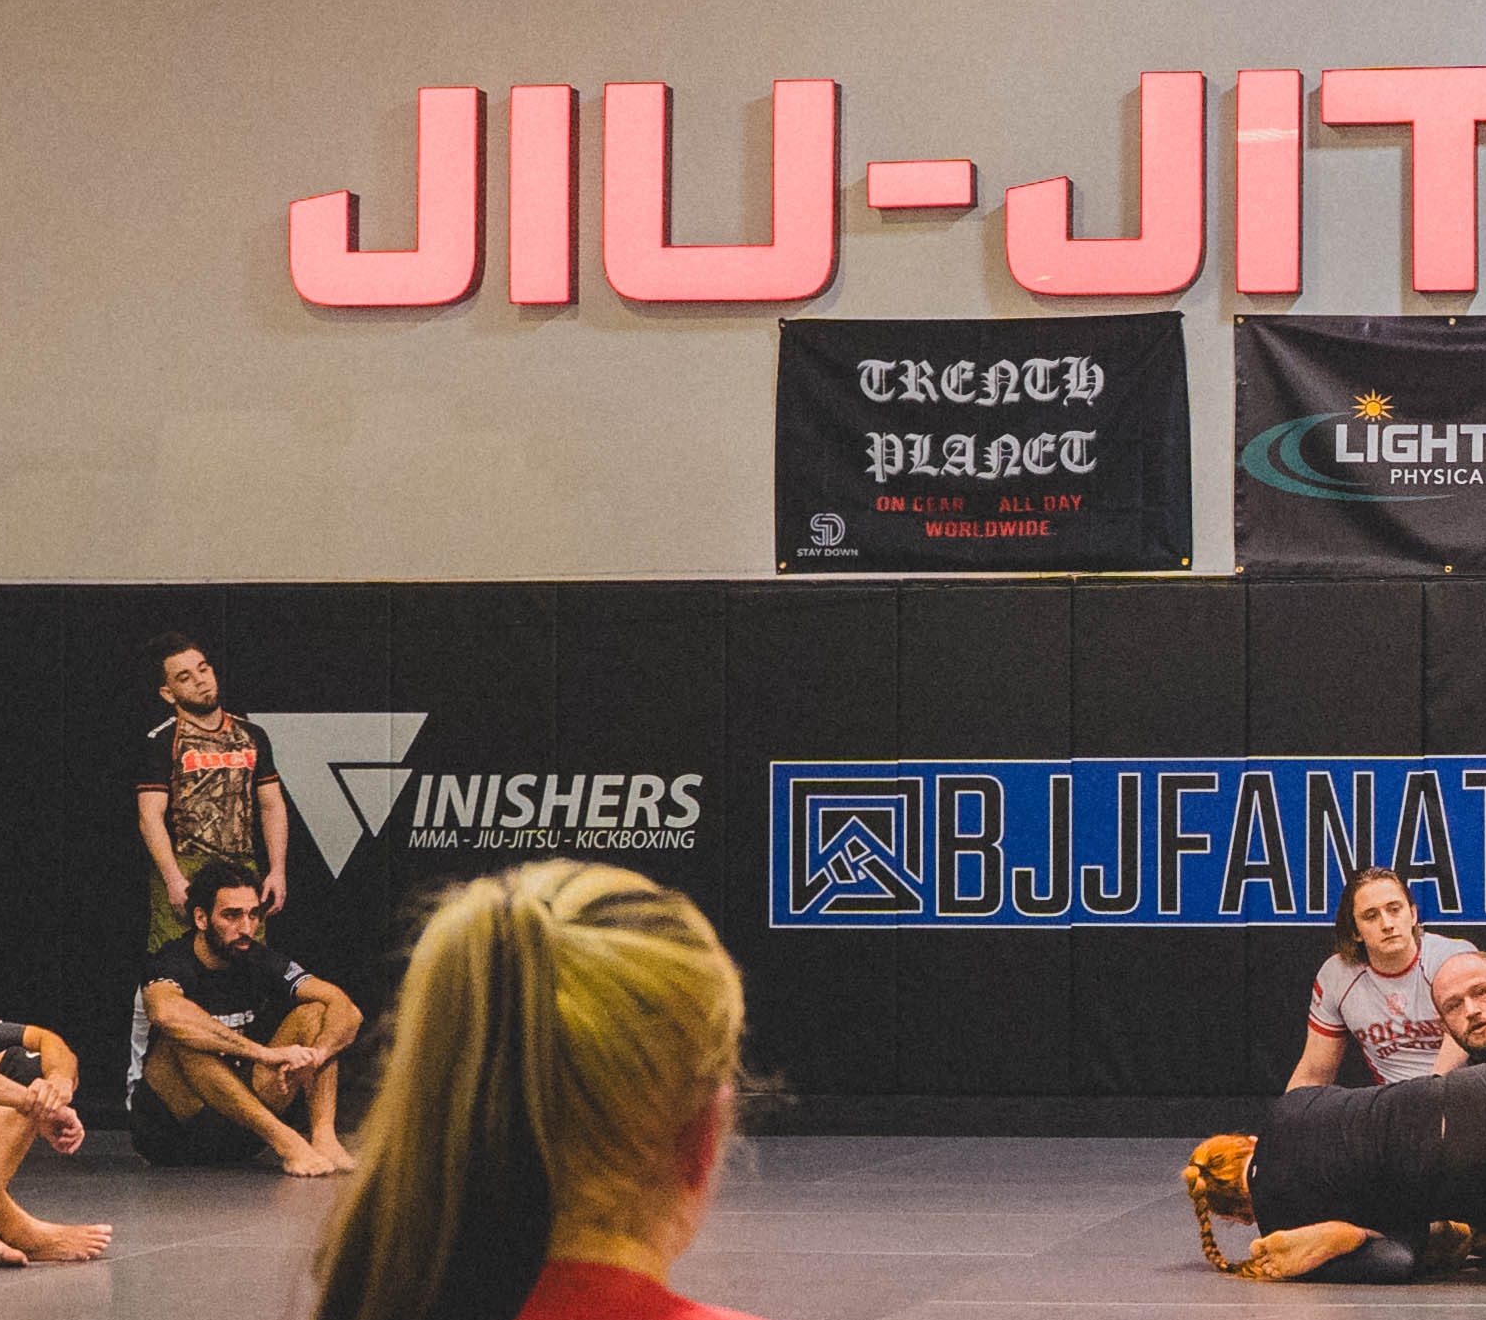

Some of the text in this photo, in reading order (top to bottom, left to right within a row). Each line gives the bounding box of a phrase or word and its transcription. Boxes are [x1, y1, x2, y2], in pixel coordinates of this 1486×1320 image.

[864, 429, 1099, 483] PLANET
[876, 496, 906, 512] ON
[998, 496, 1035, 512] ALL
[1043, 495, 1083, 511] DAY
[796, 548, 859, 557] STAY DOWN
[408, 830, 458, 849] MMA
[473, 829, 560, 849] JIU-JITSU
[575, 829, 696, 849] KICKBOXING
